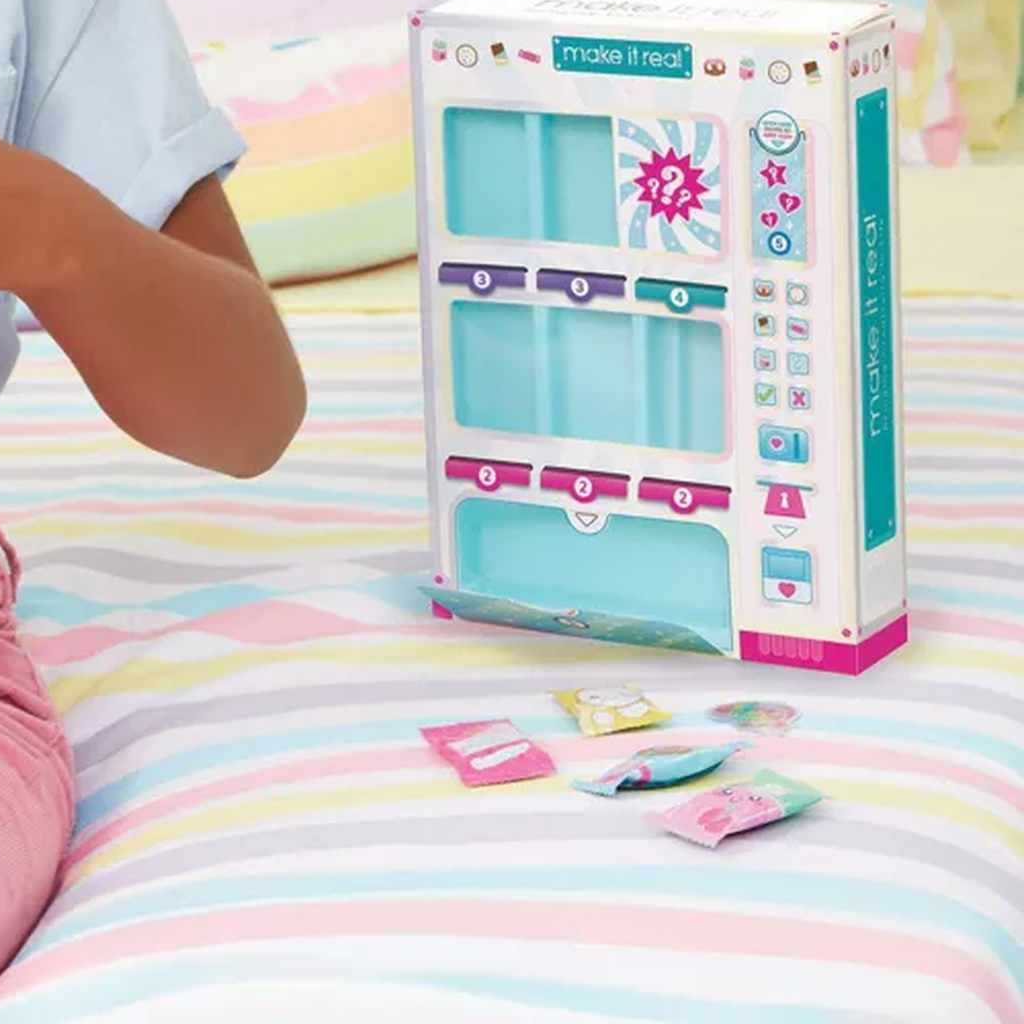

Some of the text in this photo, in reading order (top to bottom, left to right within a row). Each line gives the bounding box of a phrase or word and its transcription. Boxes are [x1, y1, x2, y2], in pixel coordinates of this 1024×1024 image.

[562, 45, 683, 68] make it real
[478, 273, 487, 285] 3
[575, 281, 585, 293] 3
[674, 291, 684, 303] 4
[863, 213, 881, 437] make it real
[483, 470, 492, 482] 2
[578, 481, 589, 493] 2
[678, 492, 688, 504] 2
